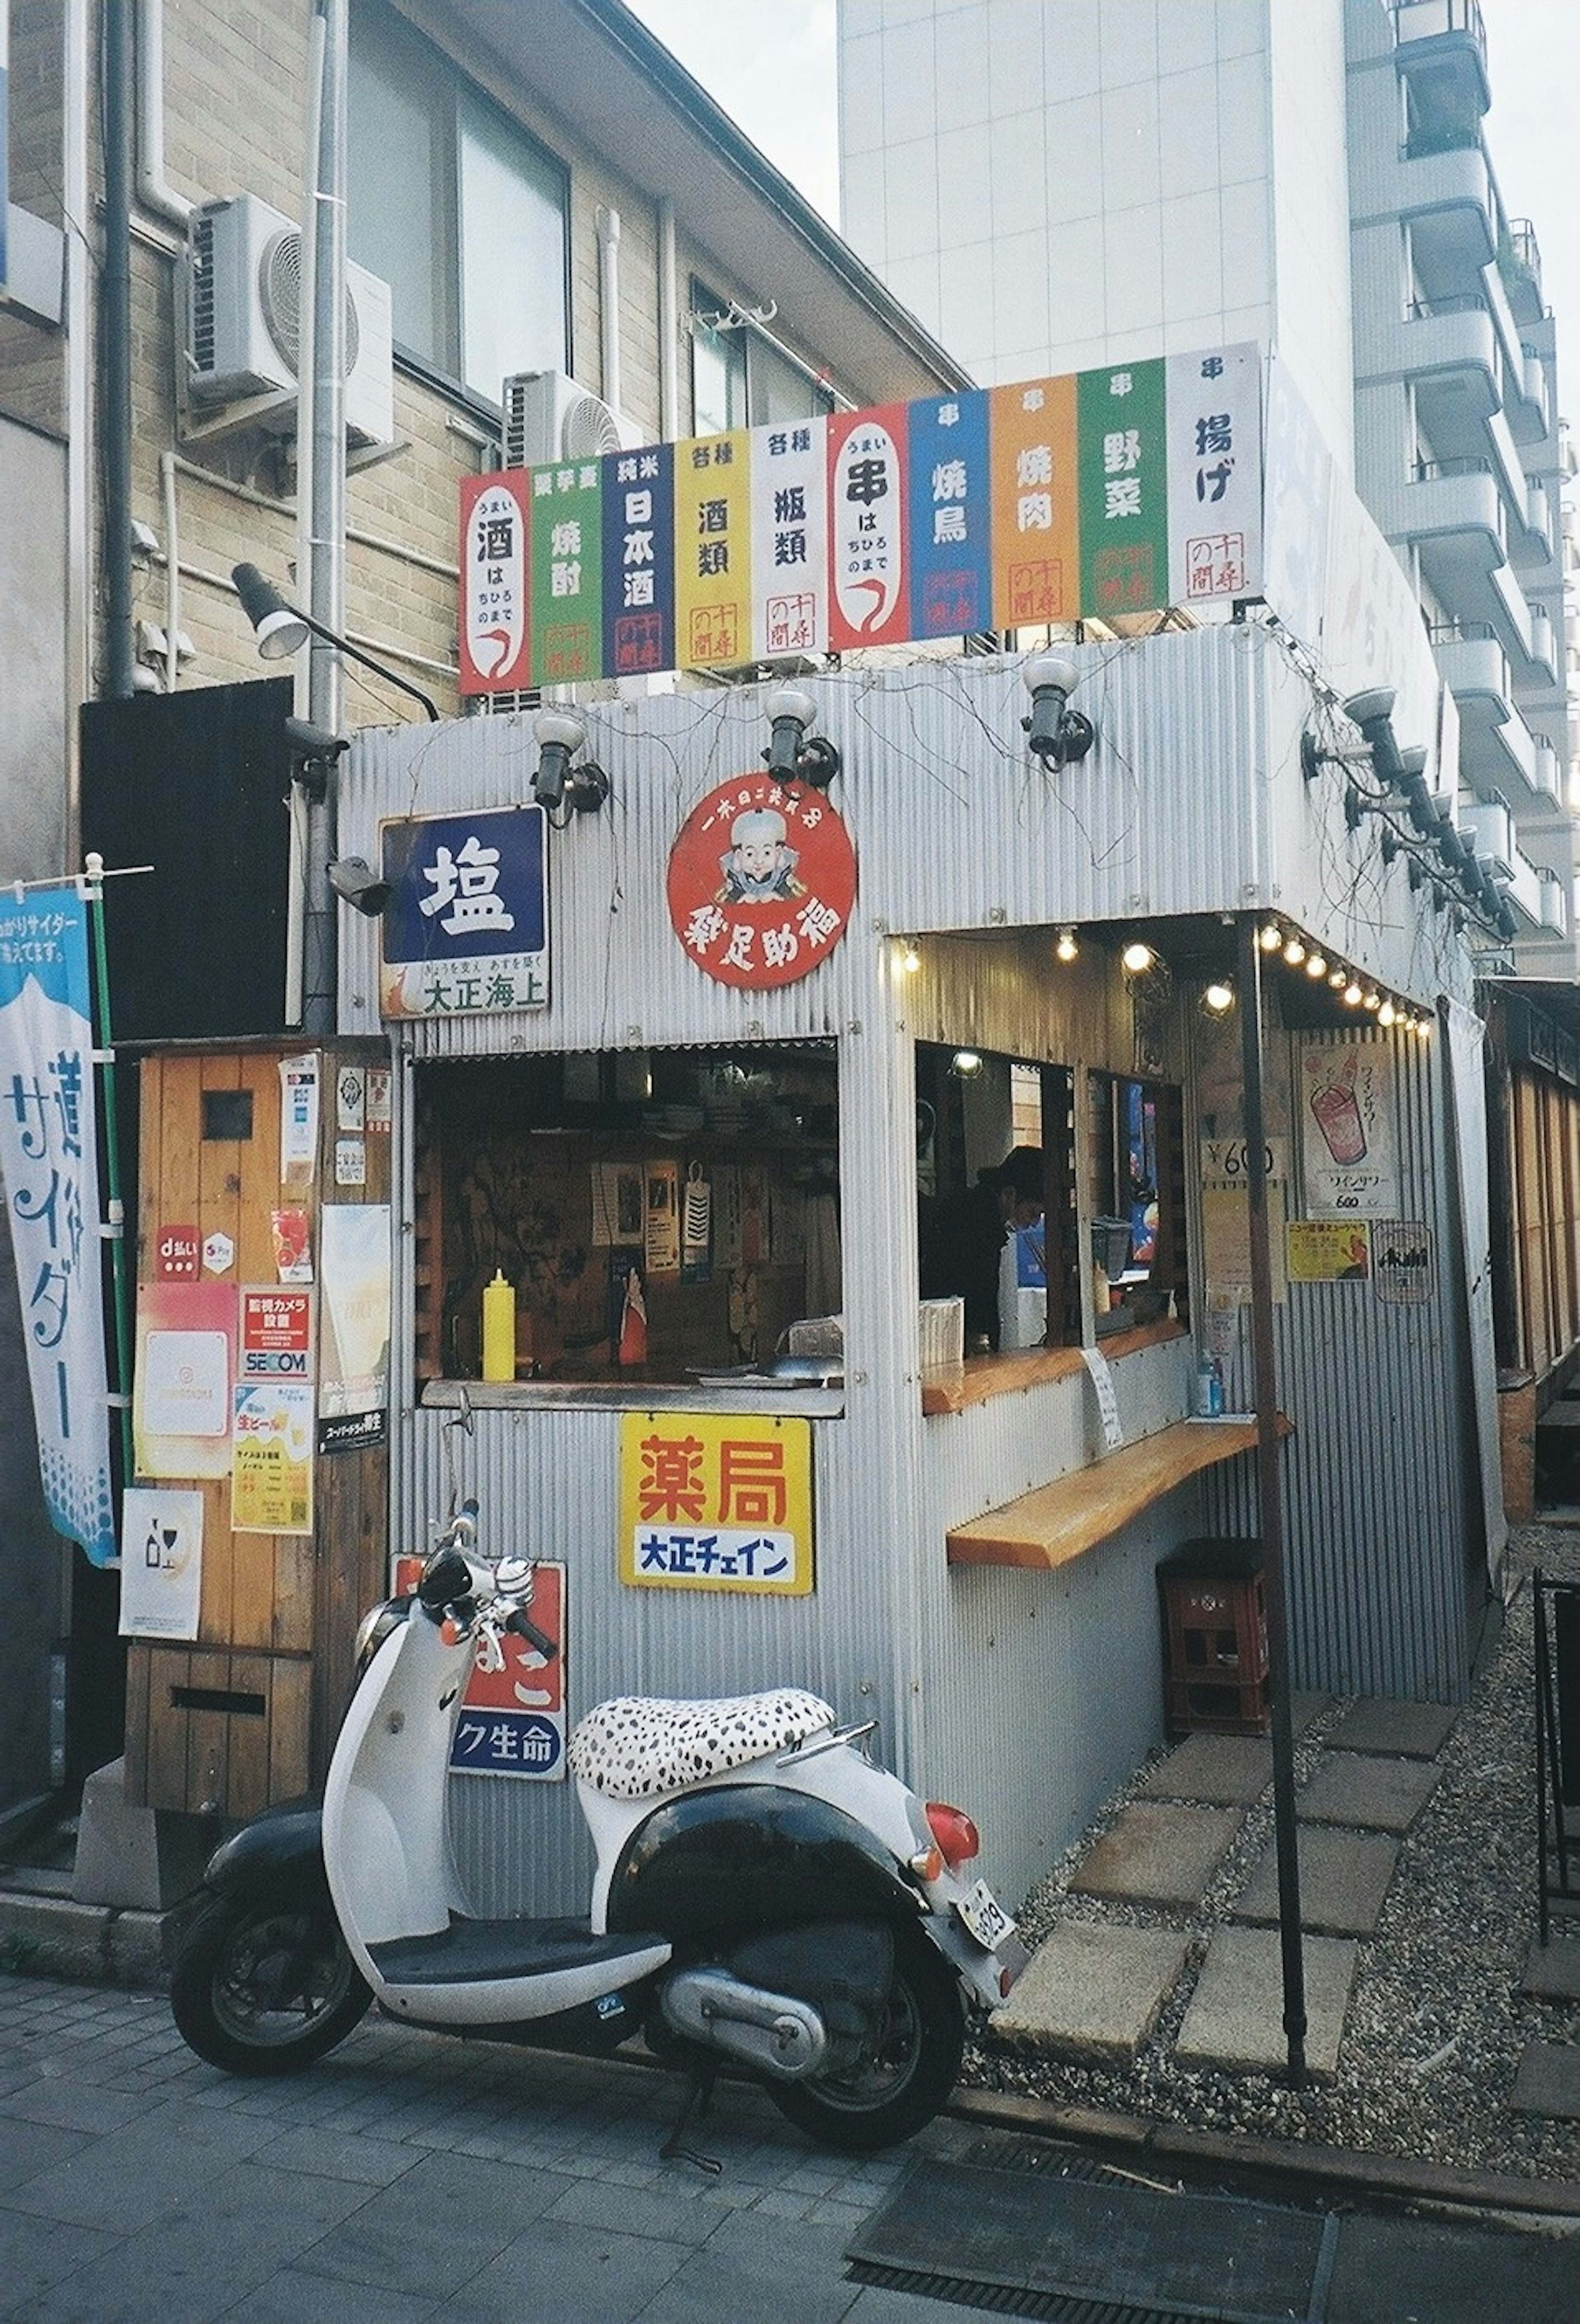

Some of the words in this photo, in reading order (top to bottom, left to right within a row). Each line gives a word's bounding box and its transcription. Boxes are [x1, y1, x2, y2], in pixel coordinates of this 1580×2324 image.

[1201, 357, 1224, 380] 串
[1110, 373, 1133, 397] 串
[1022, 388, 1046, 412] 串
[938, 403, 959, 427] 串
[768, 428, 810, 456] 各種
[848, 437, 886, 453] うまい
[616, 456, 659, 483] 純米
[692, 443, 733, 469] 各種
[1195, 414, 1234, 503] 揚げ
[846, 459, 888, 506] 串
[1104, 429, 1142, 519] 野菜
[932, 460, 967, 544] 焼鳥
[1016, 444, 1053, 533] 焼肉
[479, 501, 511, 512] うまい
[477, 517, 513, 562] 酒
[698, 498, 729, 577] 酒類
[774, 486, 806, 566] 瓶類
[624, 490, 654, 606] 日本酒
[848, 537, 887, 551] ちひろ
[551, 521, 581, 597] 焼酎
[848, 557, 887, 571] のまで
[479, 591, 513, 604] ちひろ
[479, 612, 513, 623] のまで
[419, 836, 516, 935] 塩
[424, 972, 545, 1013] 大正海上
[1336, 1195, 1359, 1208] 600
[3, 1073, 70, 1438] サイダー
[249, 1299, 305, 1313] 監視カメラ
[264, 1313, 290, 1328] 設置
[247, 1353, 306, 1371] SECOM
[639, 1434, 786, 1525] 薬局
[641, 1534, 788, 1576] 大正チェイン
